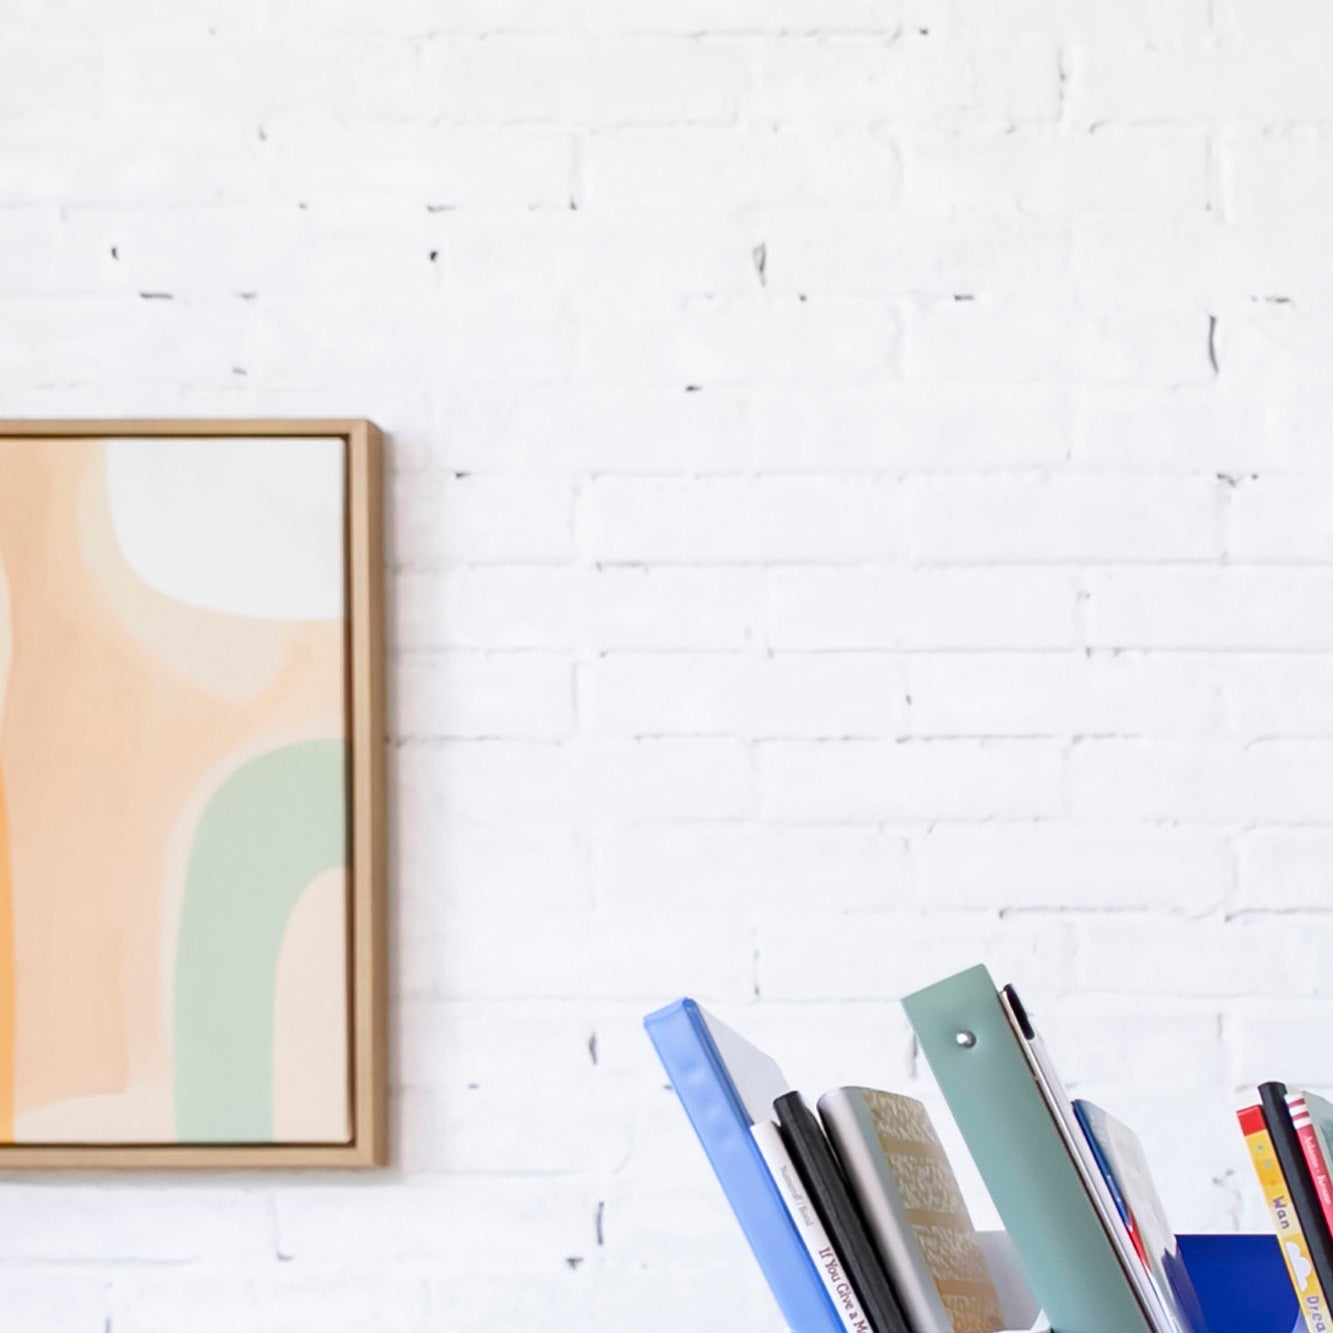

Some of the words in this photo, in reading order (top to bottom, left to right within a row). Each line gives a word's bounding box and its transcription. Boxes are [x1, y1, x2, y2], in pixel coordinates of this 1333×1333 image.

[1272, 1195, 1290, 1230] Wan
[819, 1246, 836, 1261] If
[824, 1258, 841, 1284] You
[836, 1282, 855, 1311] Give
[849, 1311, 859, 1321] a
